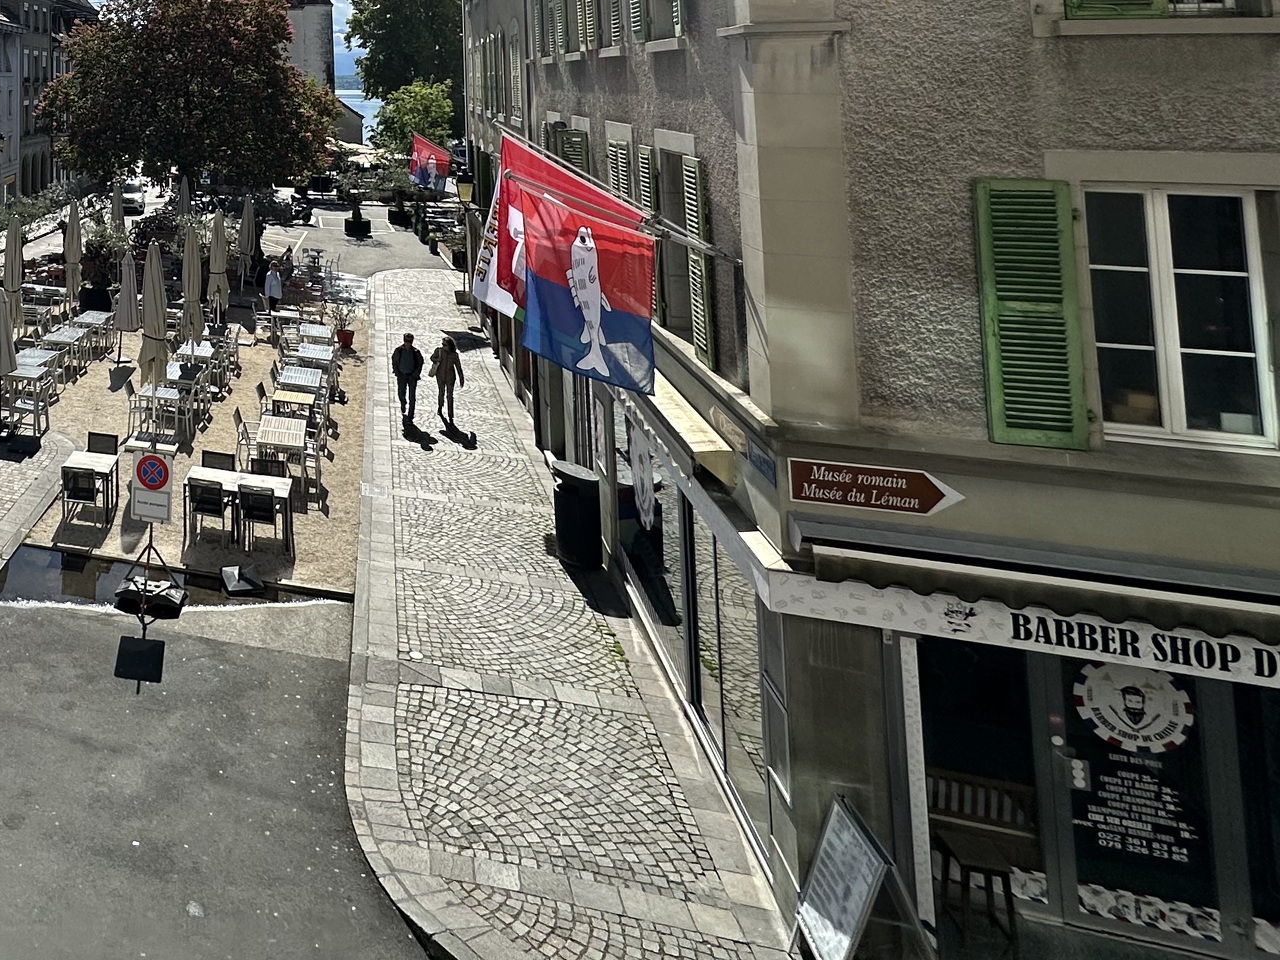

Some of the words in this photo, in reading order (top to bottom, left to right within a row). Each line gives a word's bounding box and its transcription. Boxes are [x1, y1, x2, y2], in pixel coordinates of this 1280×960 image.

[810, 465, 852, 482] Musée
[857, 474, 907, 488] romain
[801, 483, 842, 500] Musée
[847, 488, 866, 503] du
[870, 490, 920, 508] Léman
[1010, 612, 1141, 658] BARBER
[1152, 632, 1241, 672] SHOP
[1252, 647, 1280, 678] D
[1117, 729, 1140, 741] SHOP
[1109, 753, 1128, 762] LISTE
[1117, 770, 1140, 780] COUPE
[1100, 775, 1122, 785] COUPE
[1134, 781, 1159, 792] BARBE
[1105, 784, 1128, 794] COUPE
[1130, 788, 1156, 799] ENFANT
[1098, 790, 1120, 800] COUPE
[1108, 800, 1130, 810] COUPE
[1132, 804, 1156, 815] BARBE
[1098, 832, 1122, 841] 022
[1125, 836, 1146, 846] 361
[1152, 842, 1168, 851] 83
[1171, 846, 1188, 855] 64
[1098, 840, 1122, 849] 079
[1126, 844, 1149, 854] 326
[1152, 849, 1168, 858] 23
